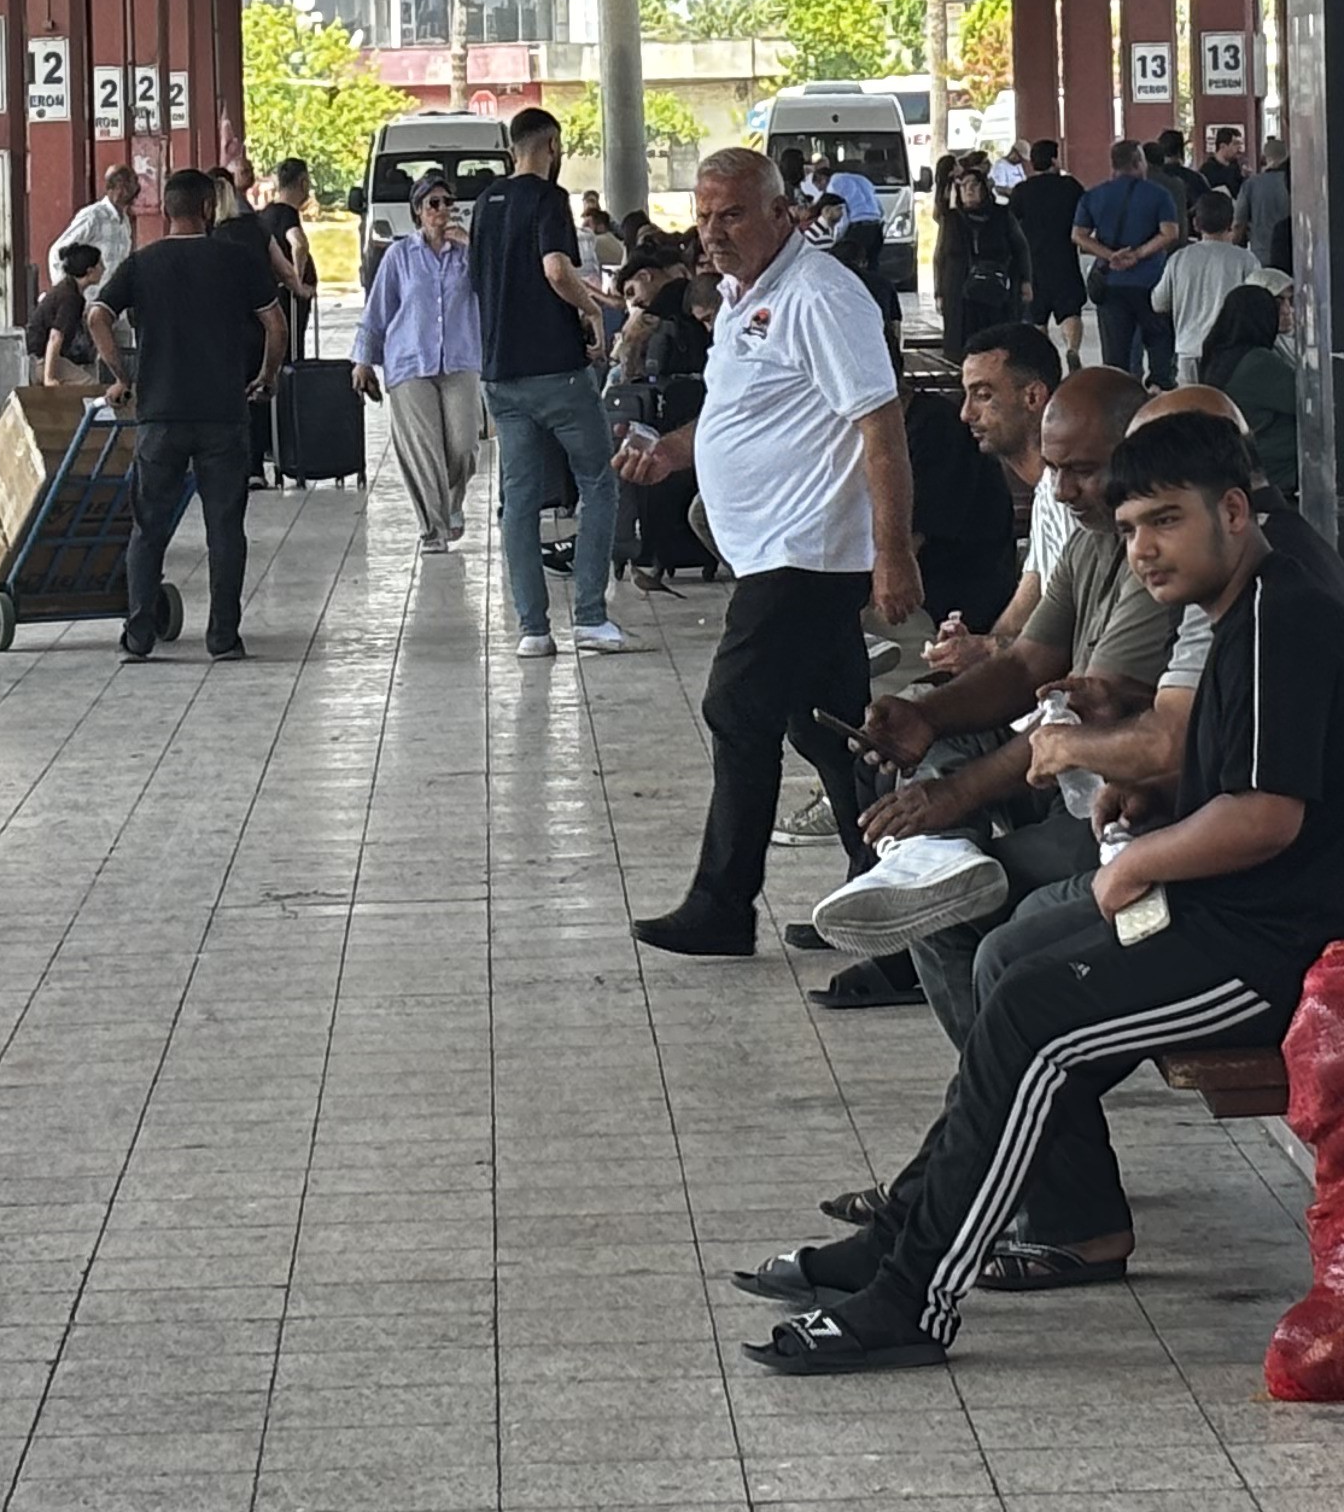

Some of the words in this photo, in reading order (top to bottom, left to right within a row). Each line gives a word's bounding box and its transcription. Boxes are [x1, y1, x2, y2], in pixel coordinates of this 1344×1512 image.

[1136, 54, 1167, 79] 13
[1207, 43, 1242, 71] 13
[29, 93, 65, 108] ERON
